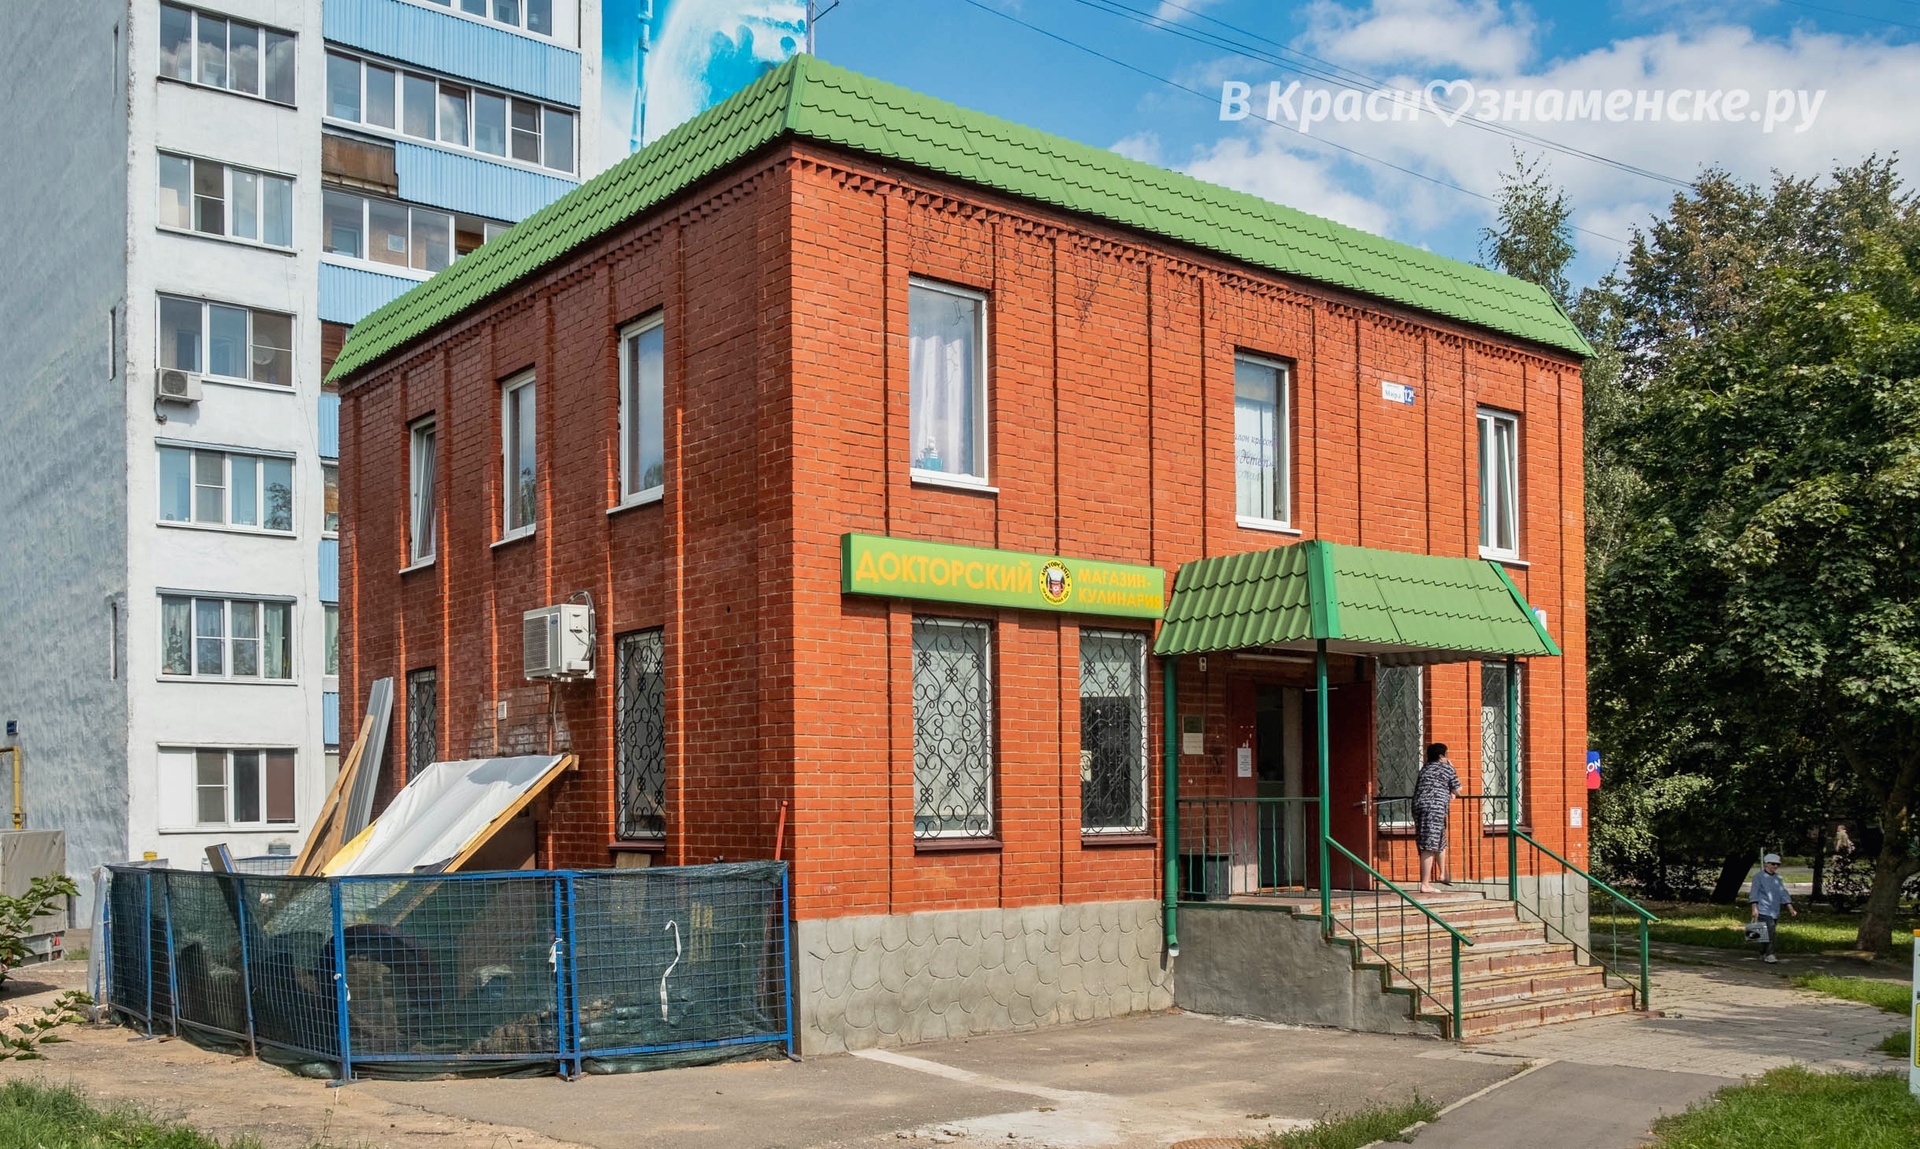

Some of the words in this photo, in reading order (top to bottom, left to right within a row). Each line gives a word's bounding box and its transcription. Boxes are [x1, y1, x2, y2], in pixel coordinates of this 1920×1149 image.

[855, 550, 1033, 594] ДОКТОРСКИЙ
[1078, 568, 1151, 588] МАГАЗИН-
[1078, 587, 1161, 609] КУЛИНАРИЯ
